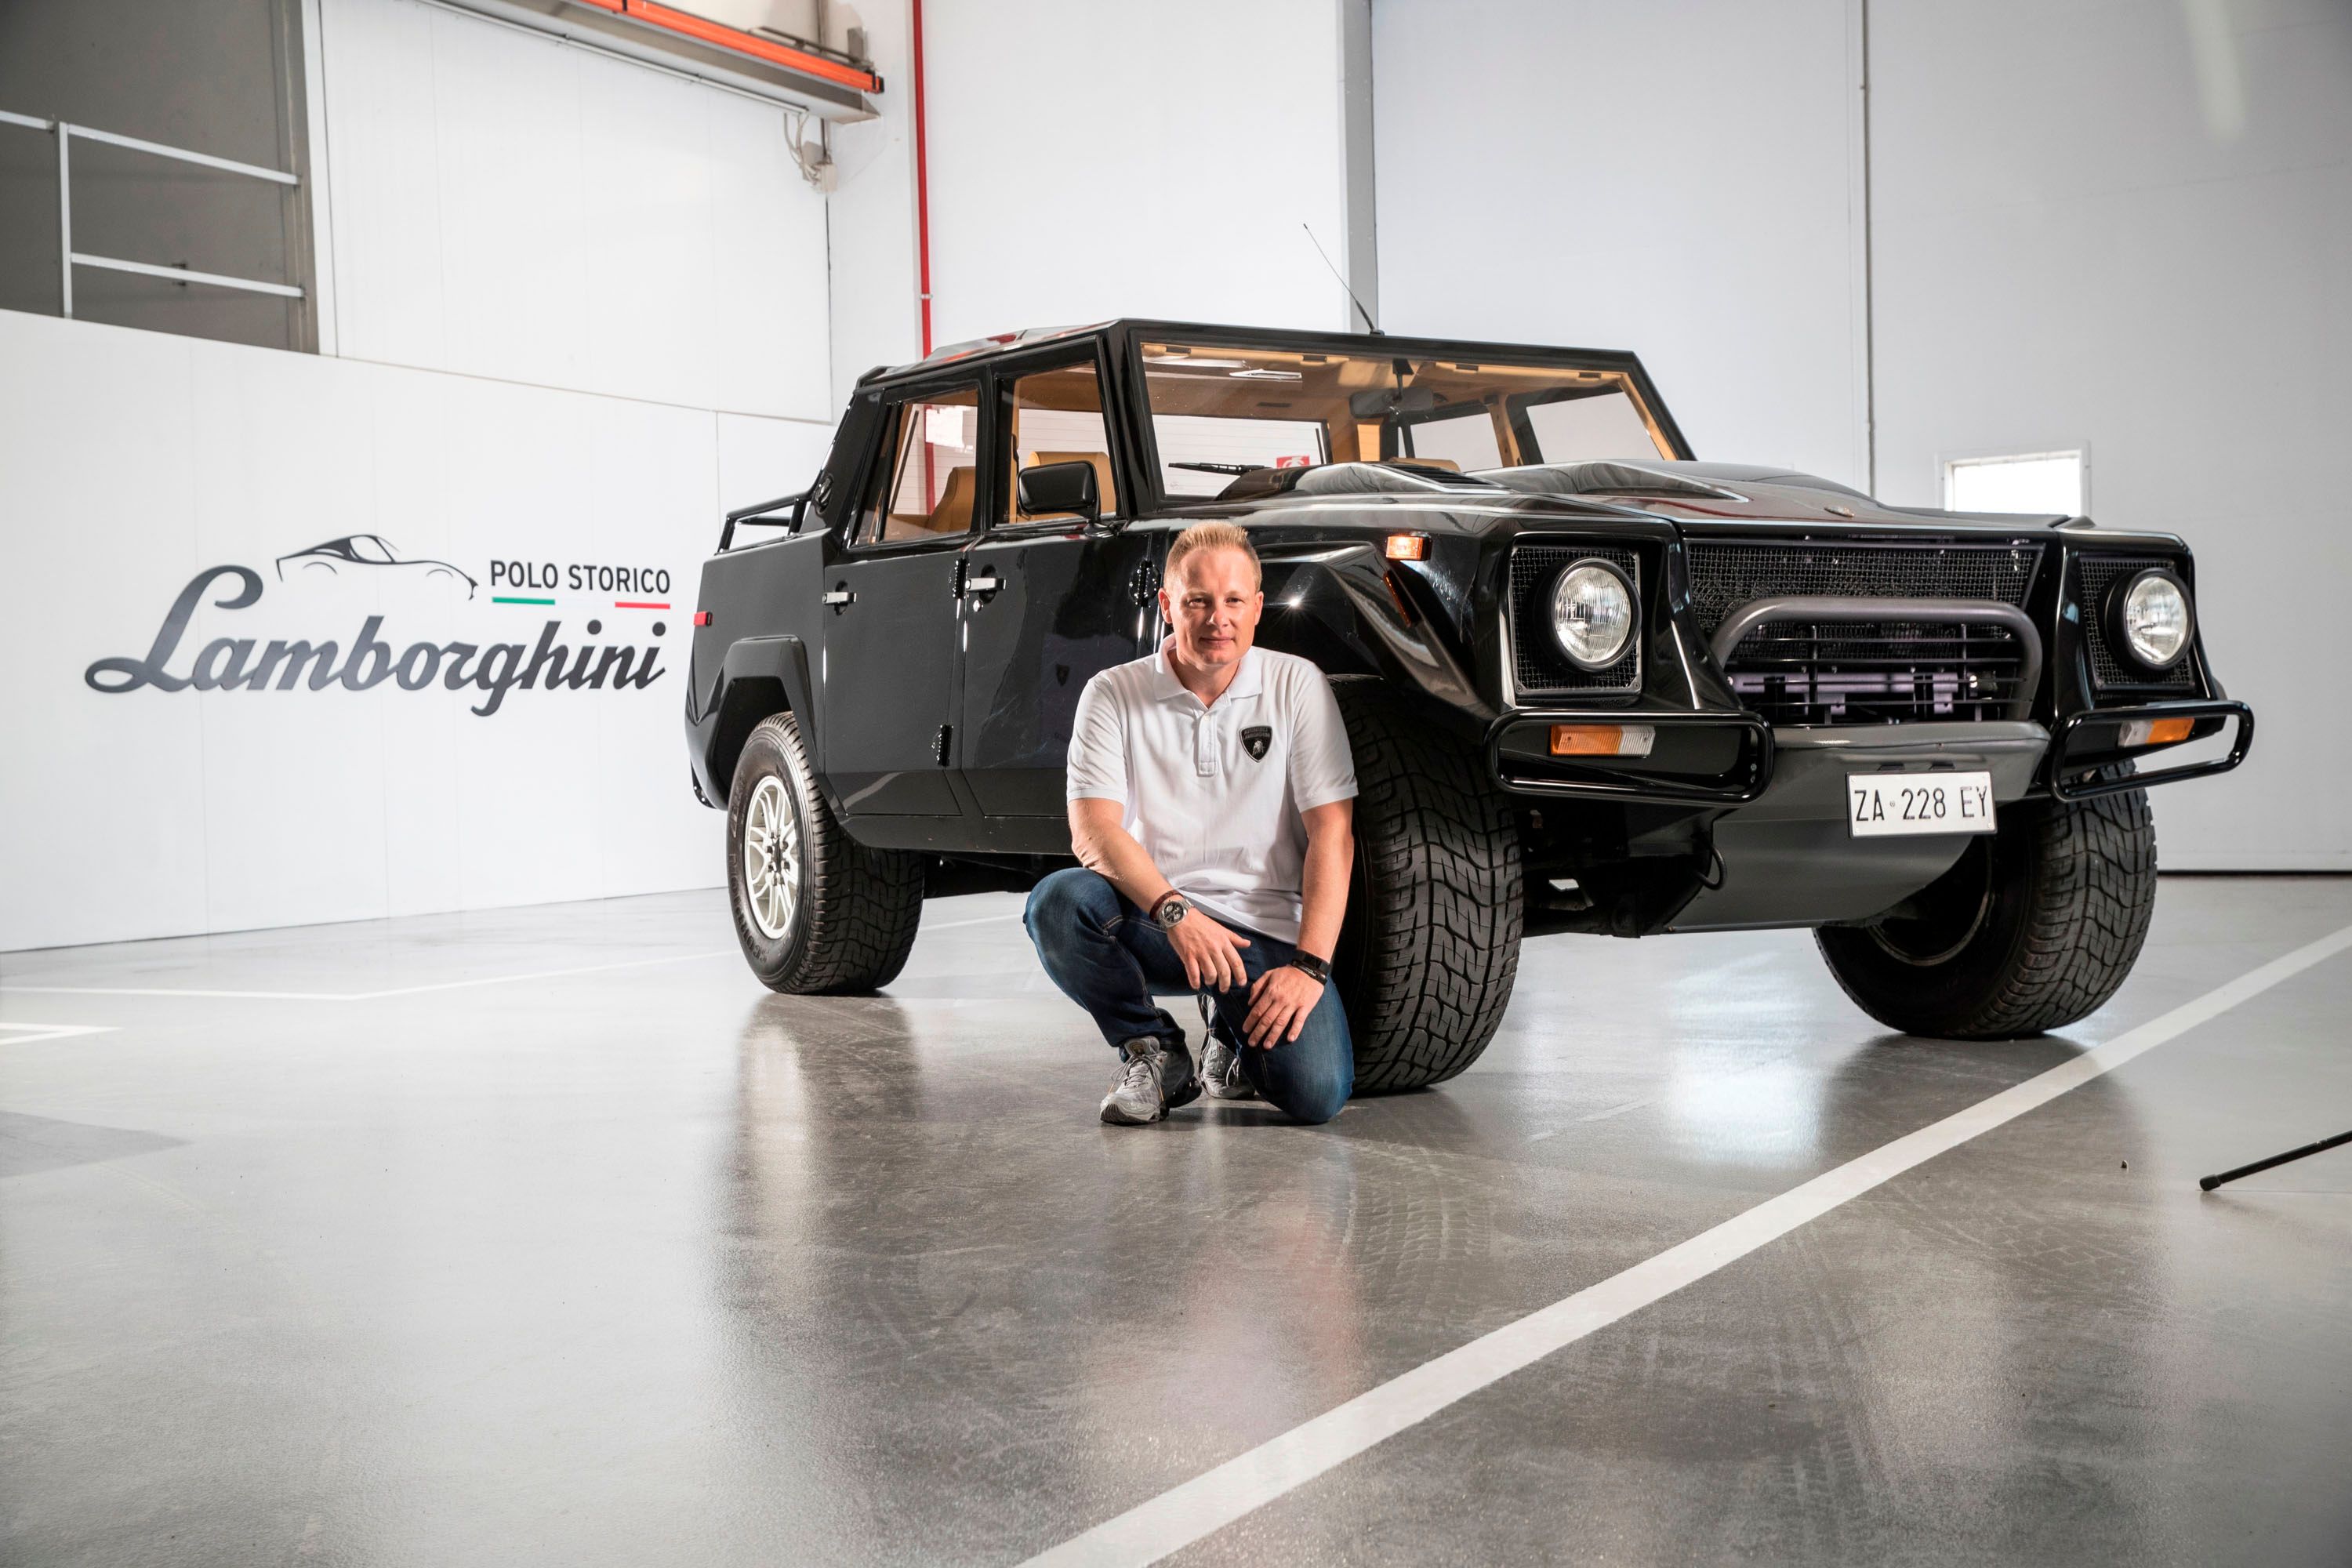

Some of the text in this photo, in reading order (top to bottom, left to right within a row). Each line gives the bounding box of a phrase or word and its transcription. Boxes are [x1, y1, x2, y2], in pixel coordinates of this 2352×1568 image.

[490, 560, 670, 594] POLO STORICO
[85, 564, 666, 717] Lamborghini
[1854, 786, 1987, 821] ZA 228 EY
